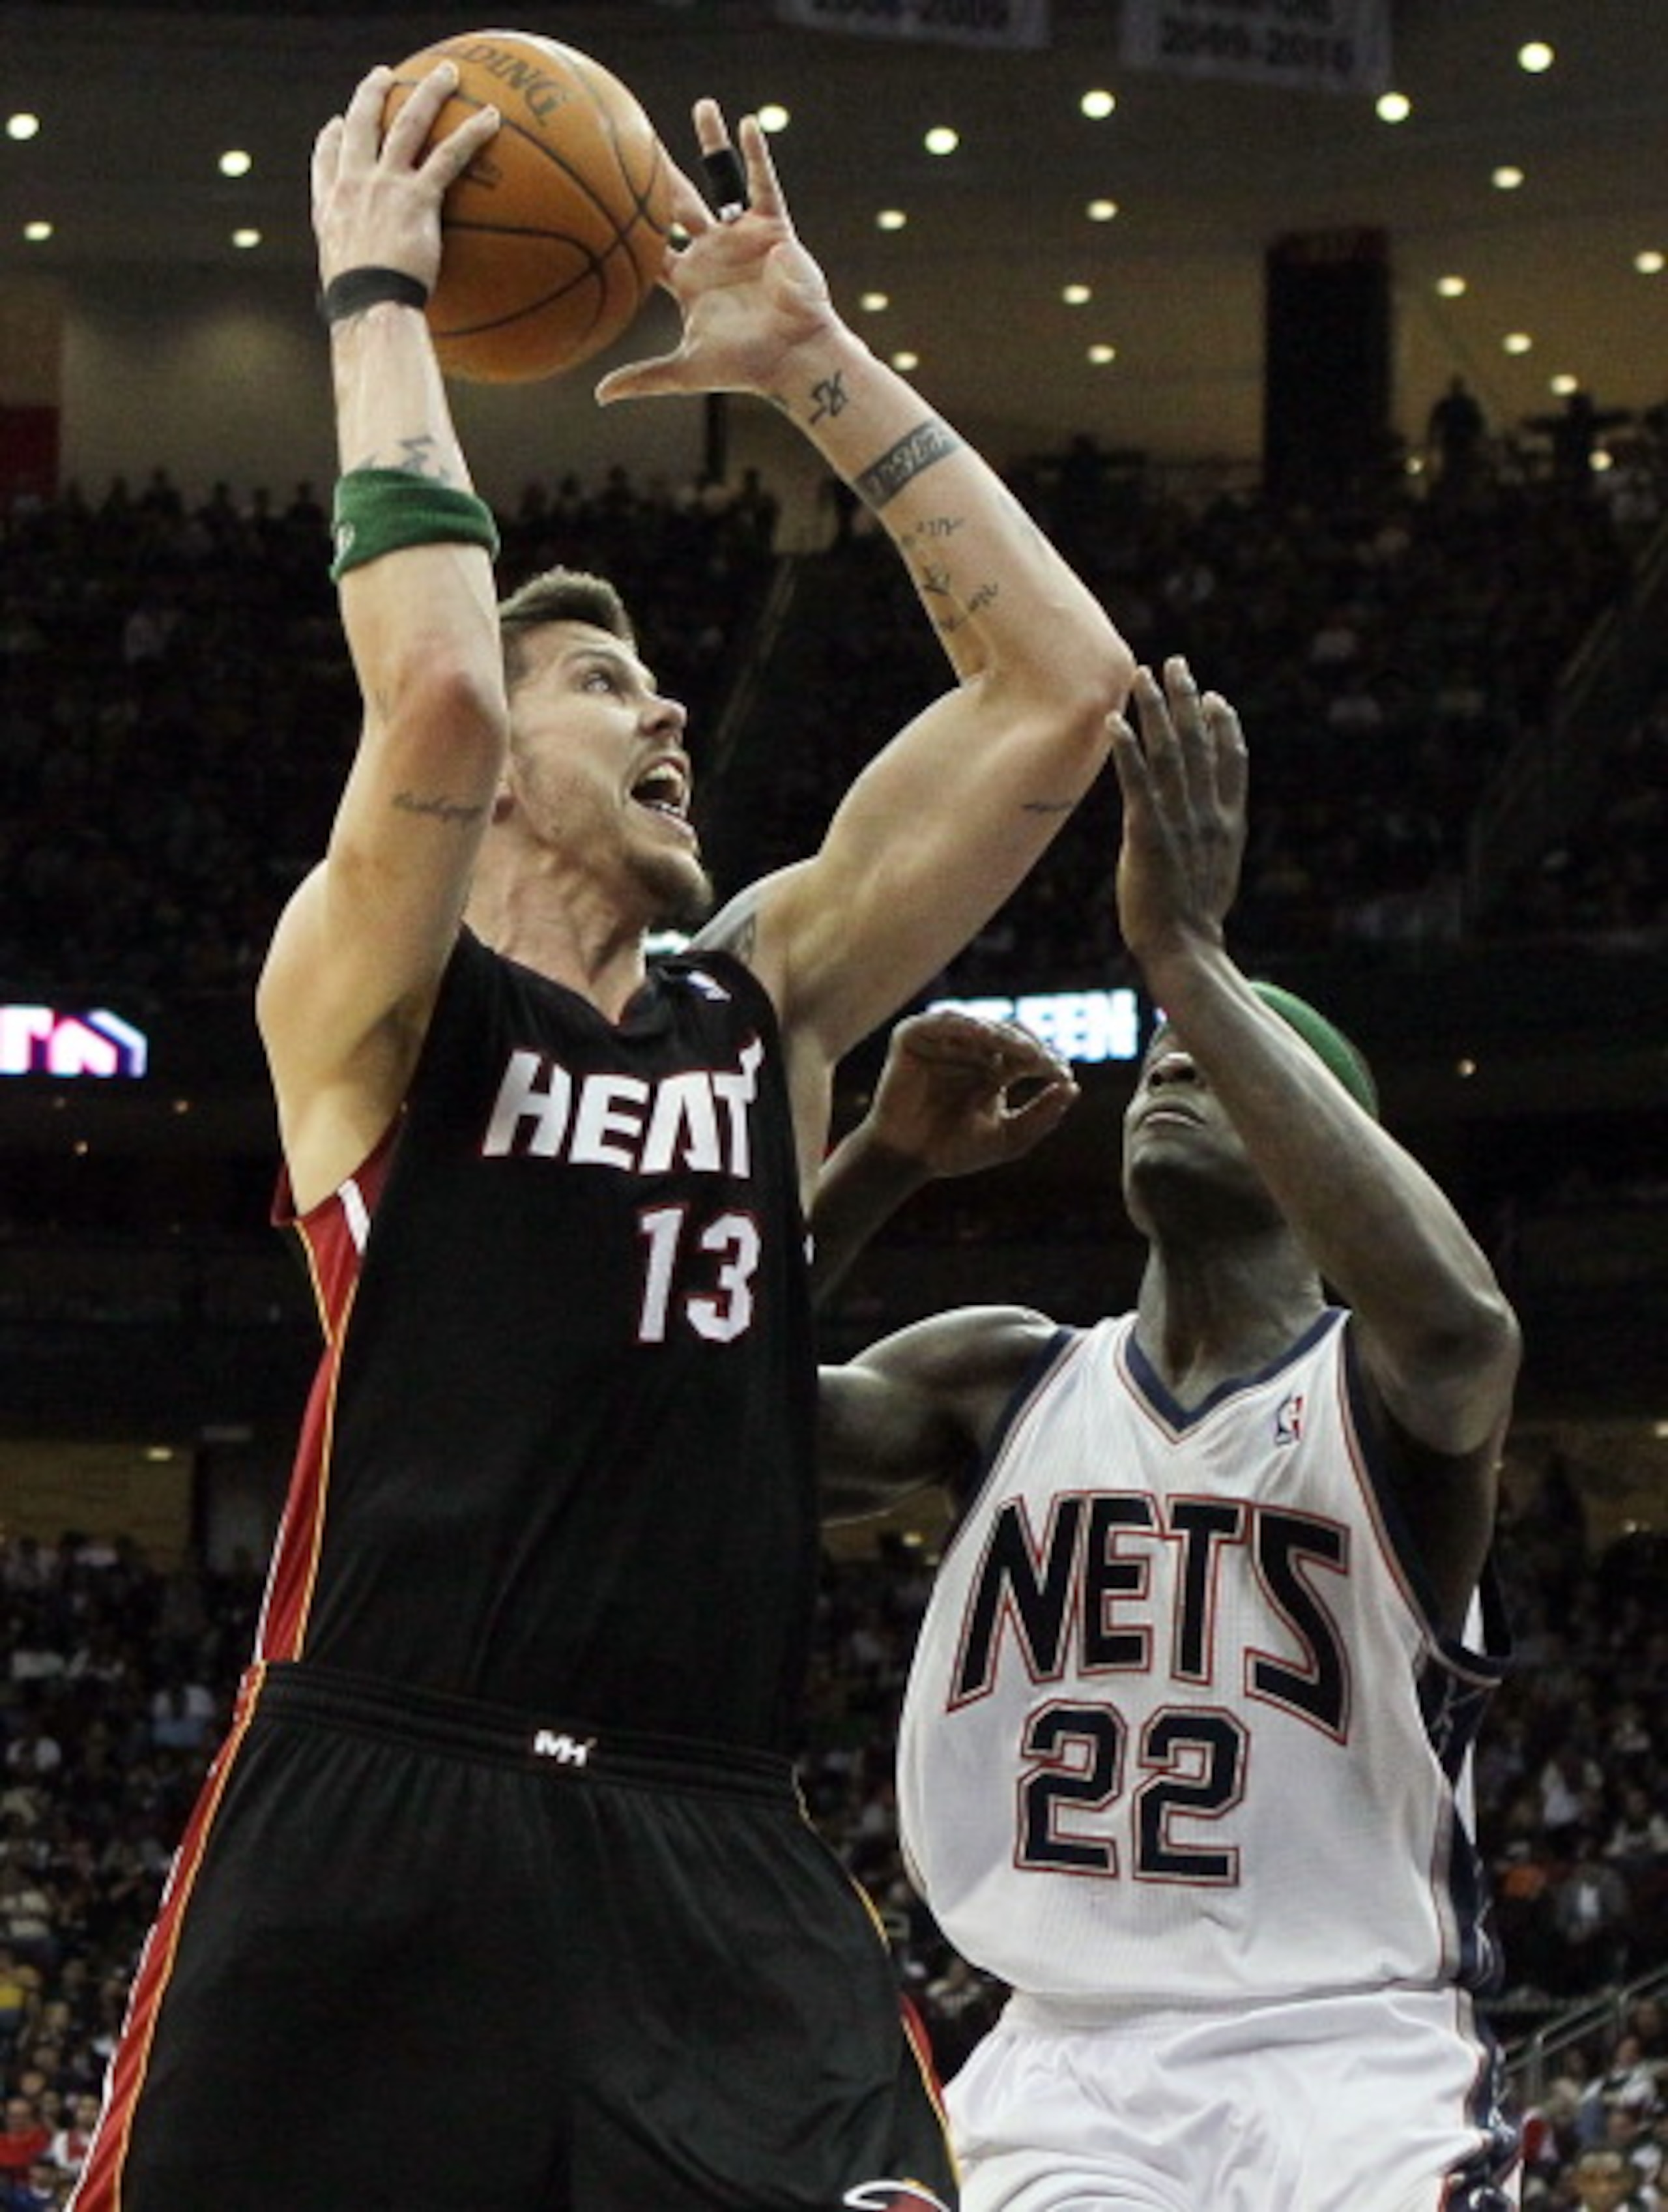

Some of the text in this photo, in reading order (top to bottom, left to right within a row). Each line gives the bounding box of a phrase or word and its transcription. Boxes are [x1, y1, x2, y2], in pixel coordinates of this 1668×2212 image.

[482, 1037, 765, 1178] HEAT
[638, 1204, 761, 1343] 13
[947, 1490, 1352, 1747] NETS
[1014, 1699, 1250, 1886] 22
